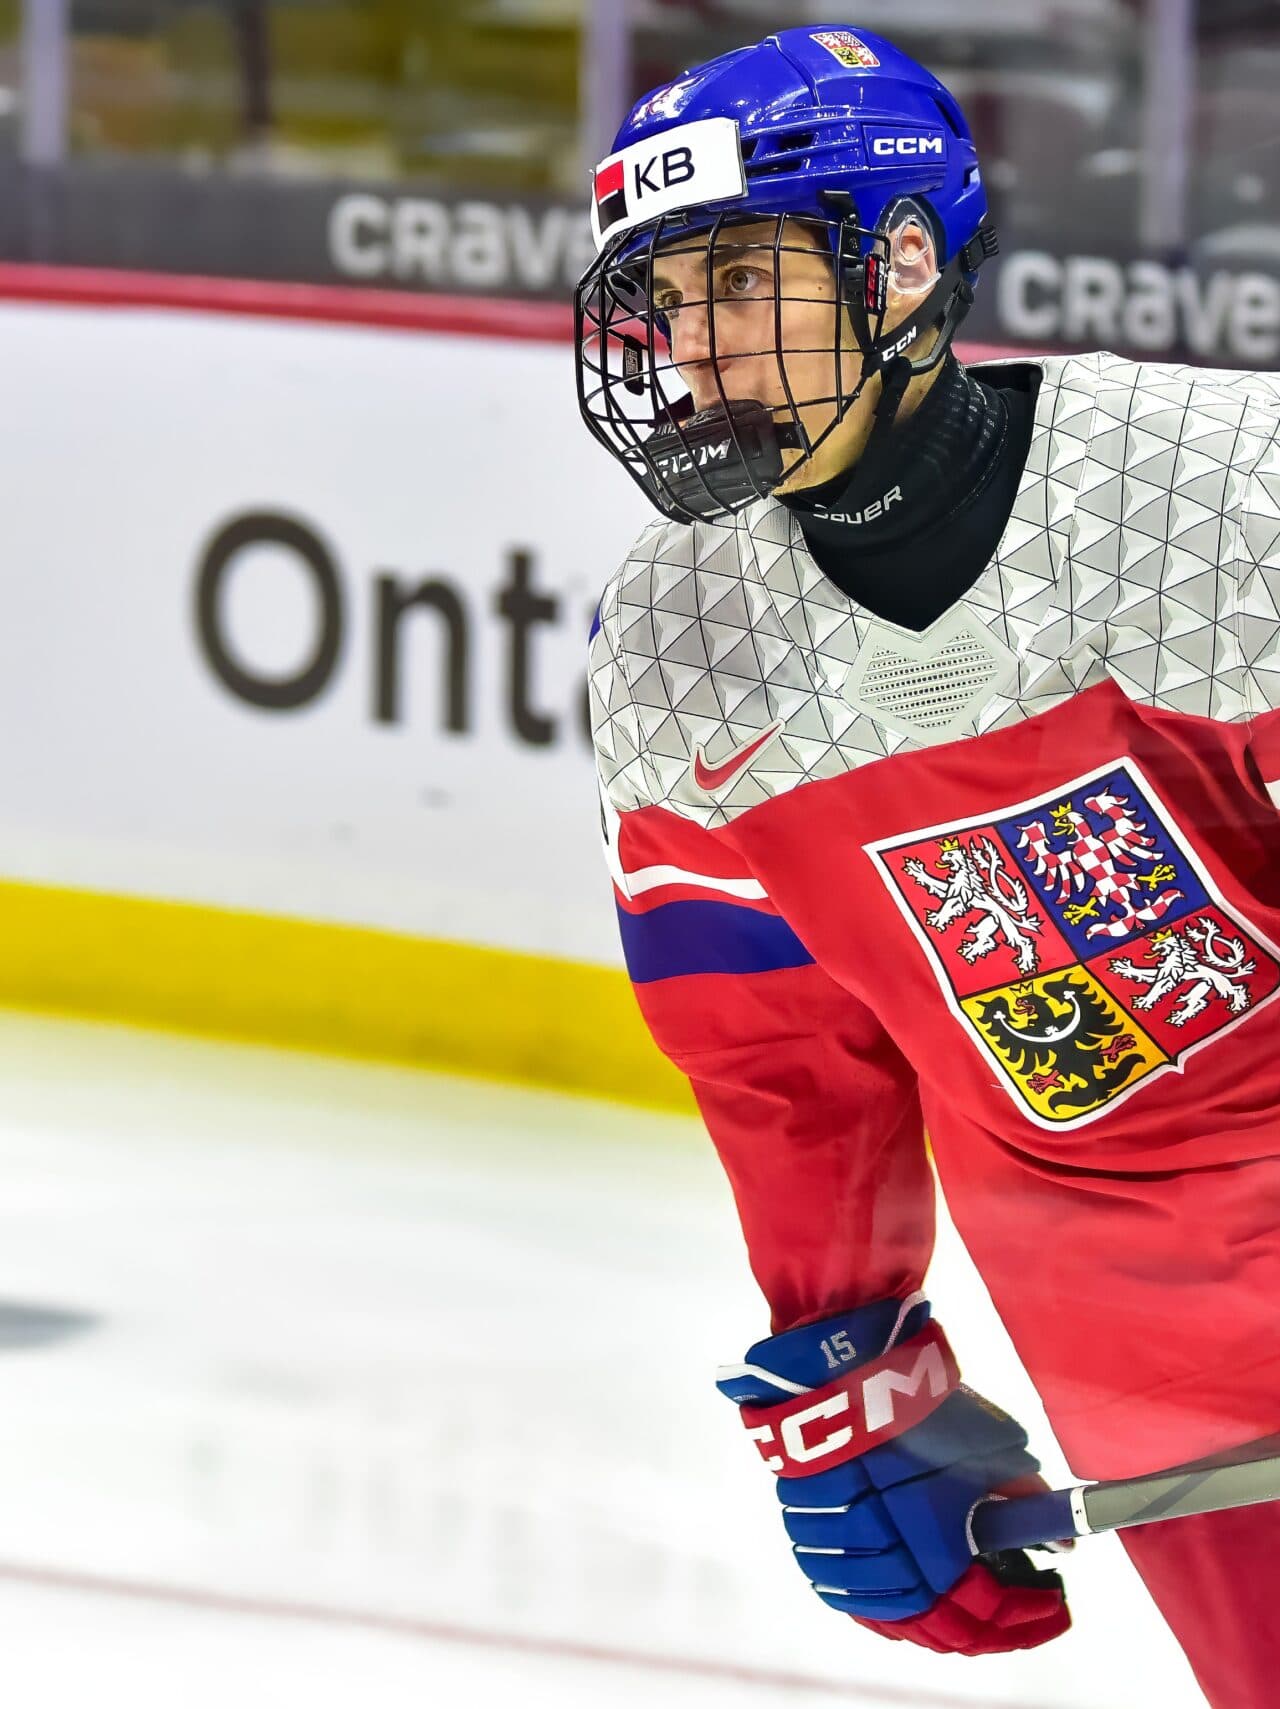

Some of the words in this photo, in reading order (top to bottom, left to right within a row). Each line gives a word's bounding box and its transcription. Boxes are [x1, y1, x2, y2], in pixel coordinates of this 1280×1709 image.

[872, 136, 943, 156] CCM
[634, 146, 696, 200] KB
[881, 325, 917, 362] CCM
[188, 505, 595, 756] Ont
[819, 1330, 858, 1369] 15
